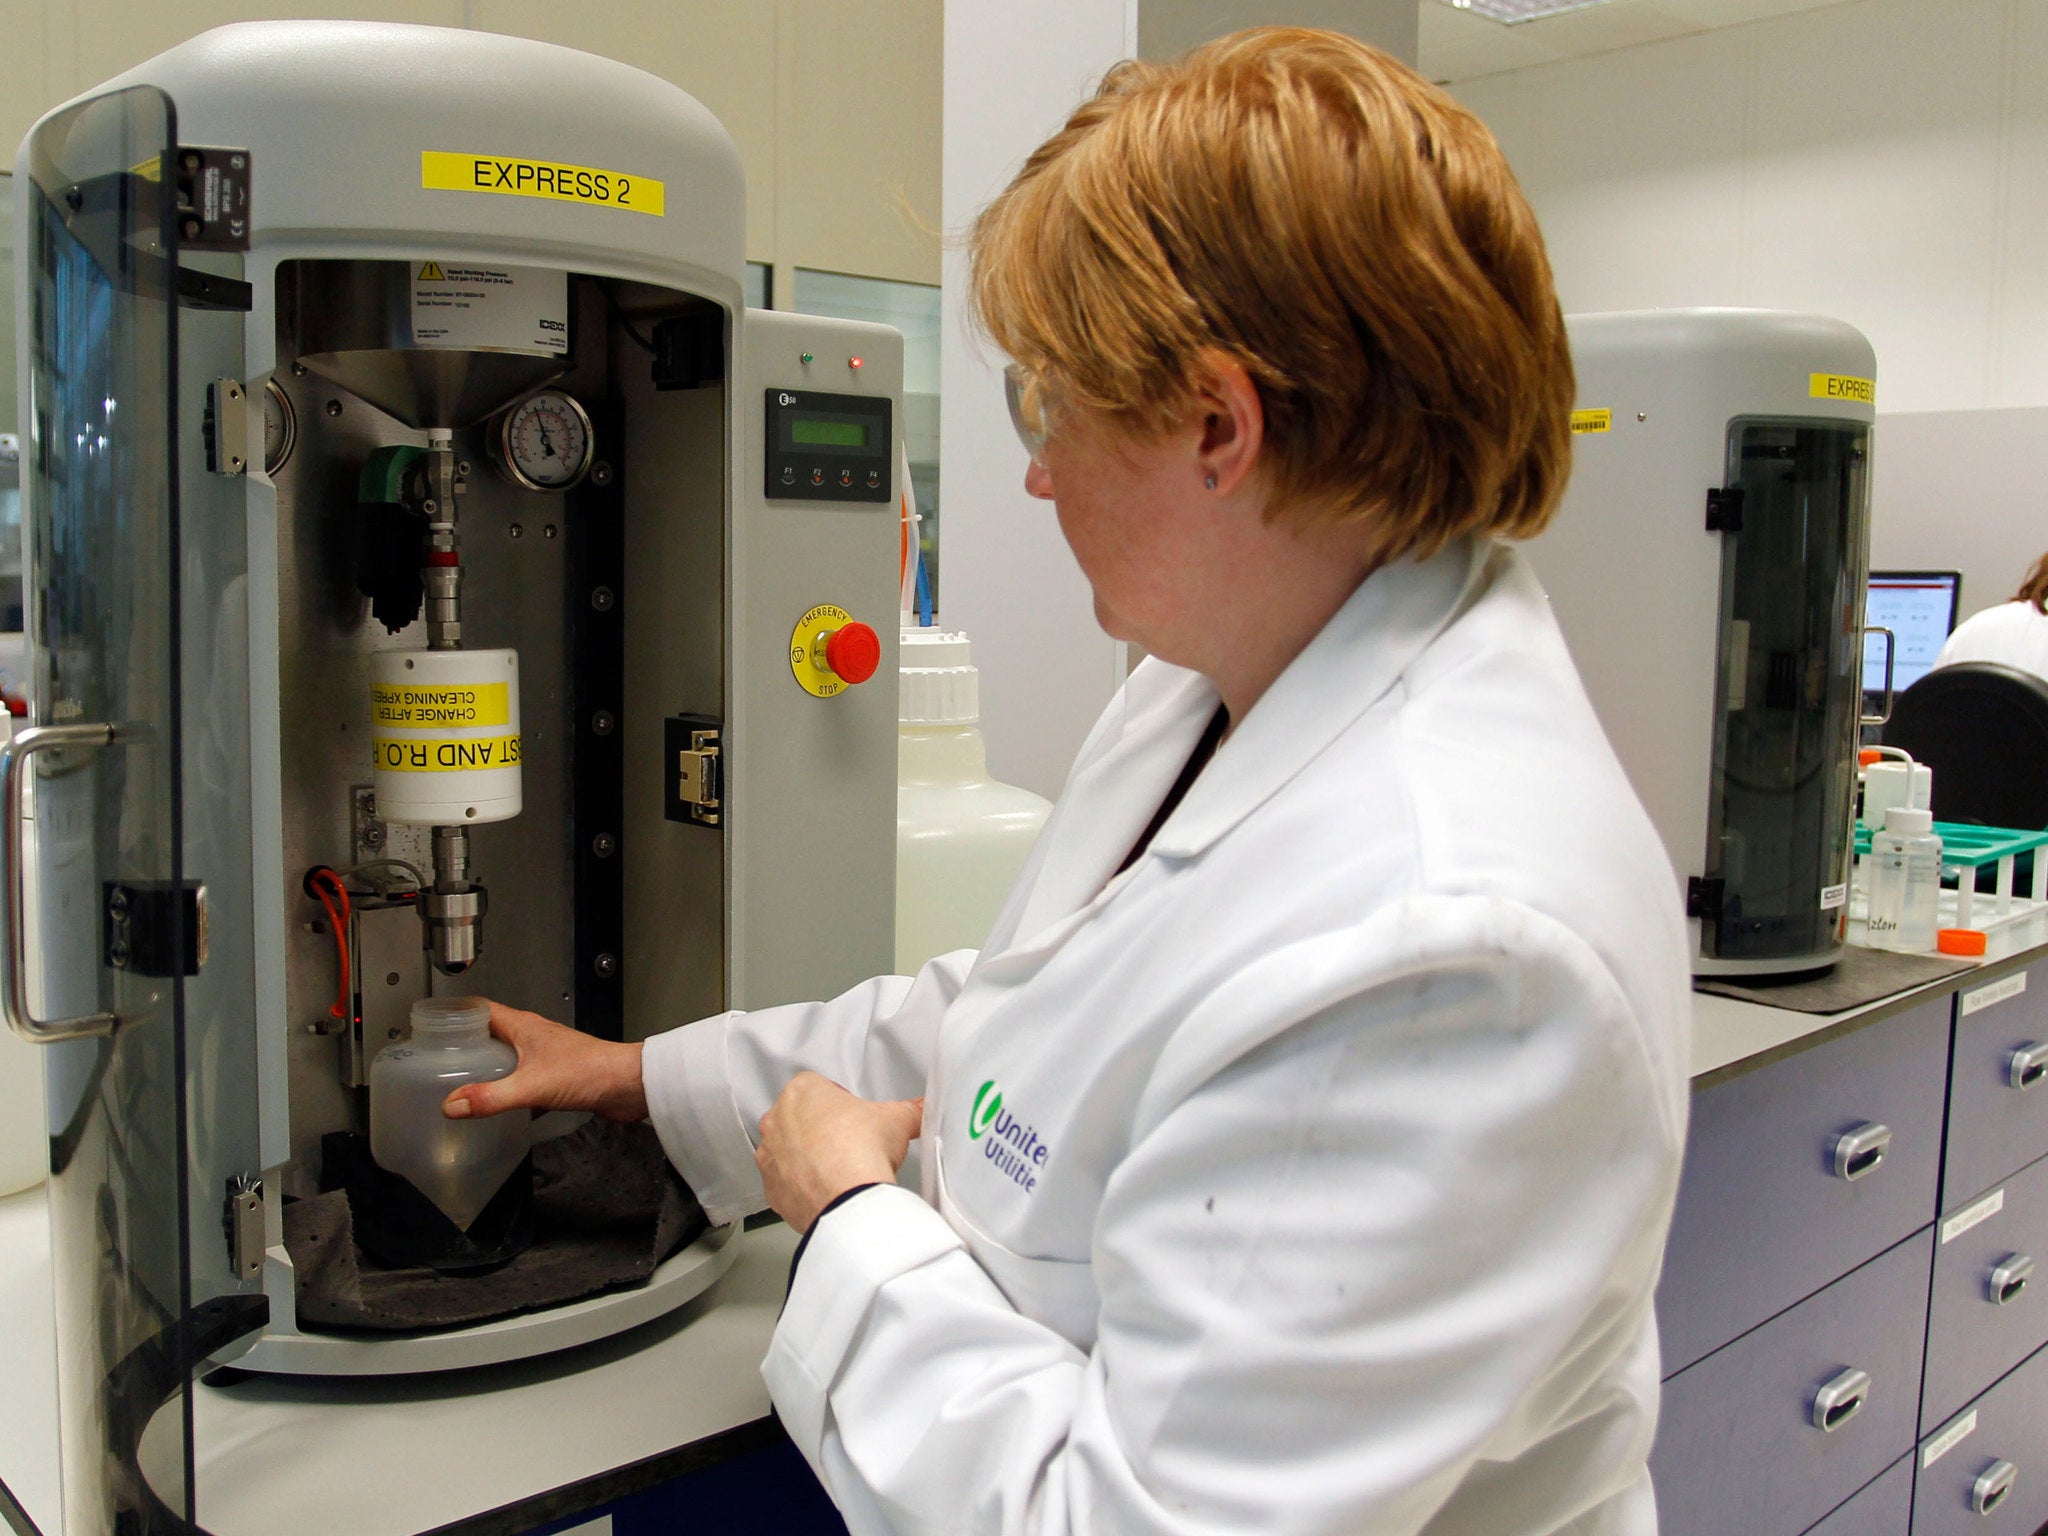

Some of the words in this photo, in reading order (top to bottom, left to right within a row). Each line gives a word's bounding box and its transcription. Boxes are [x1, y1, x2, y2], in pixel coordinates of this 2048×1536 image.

[474, 160, 609, 201] EXPRESS
[617, 178, 630, 204] 2
[784, 467, 792, 475] F1
[813, 468, 821, 476] F2
[801, 606, 848, 628] EMERGENCY
[818, 683, 838, 695] STOP
[373, 690, 402, 704] XPRE
[405, 691, 475, 704] CLEANING
[379, 707, 412, 720] AFTER
[416, 708, 476, 721] CHANGE
[383, 743, 426, 766] R.O.
[437, 743, 493, 766] AND
[995, 1108, 1049, 1169] Unite
[985, 1136, 1036, 1194] Utilitie
